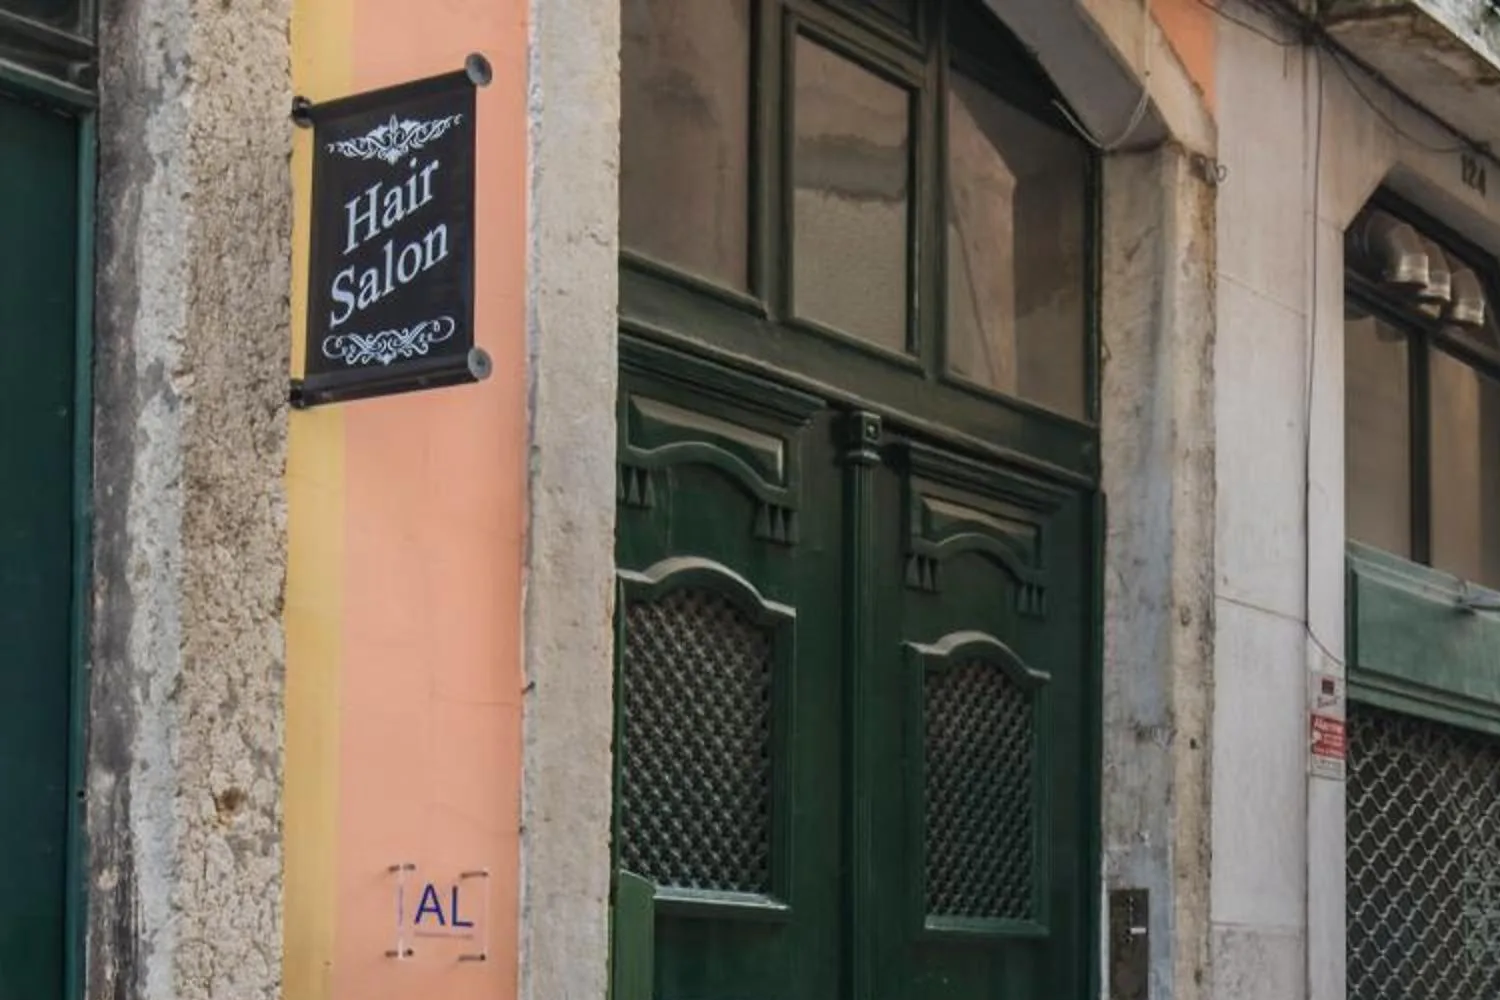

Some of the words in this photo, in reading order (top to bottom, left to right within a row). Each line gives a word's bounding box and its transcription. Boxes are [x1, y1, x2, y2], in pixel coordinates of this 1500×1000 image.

[343, 157, 440, 255] Hair
[330, 223, 449, 329] Salon
[414, 883, 474, 928] AL
